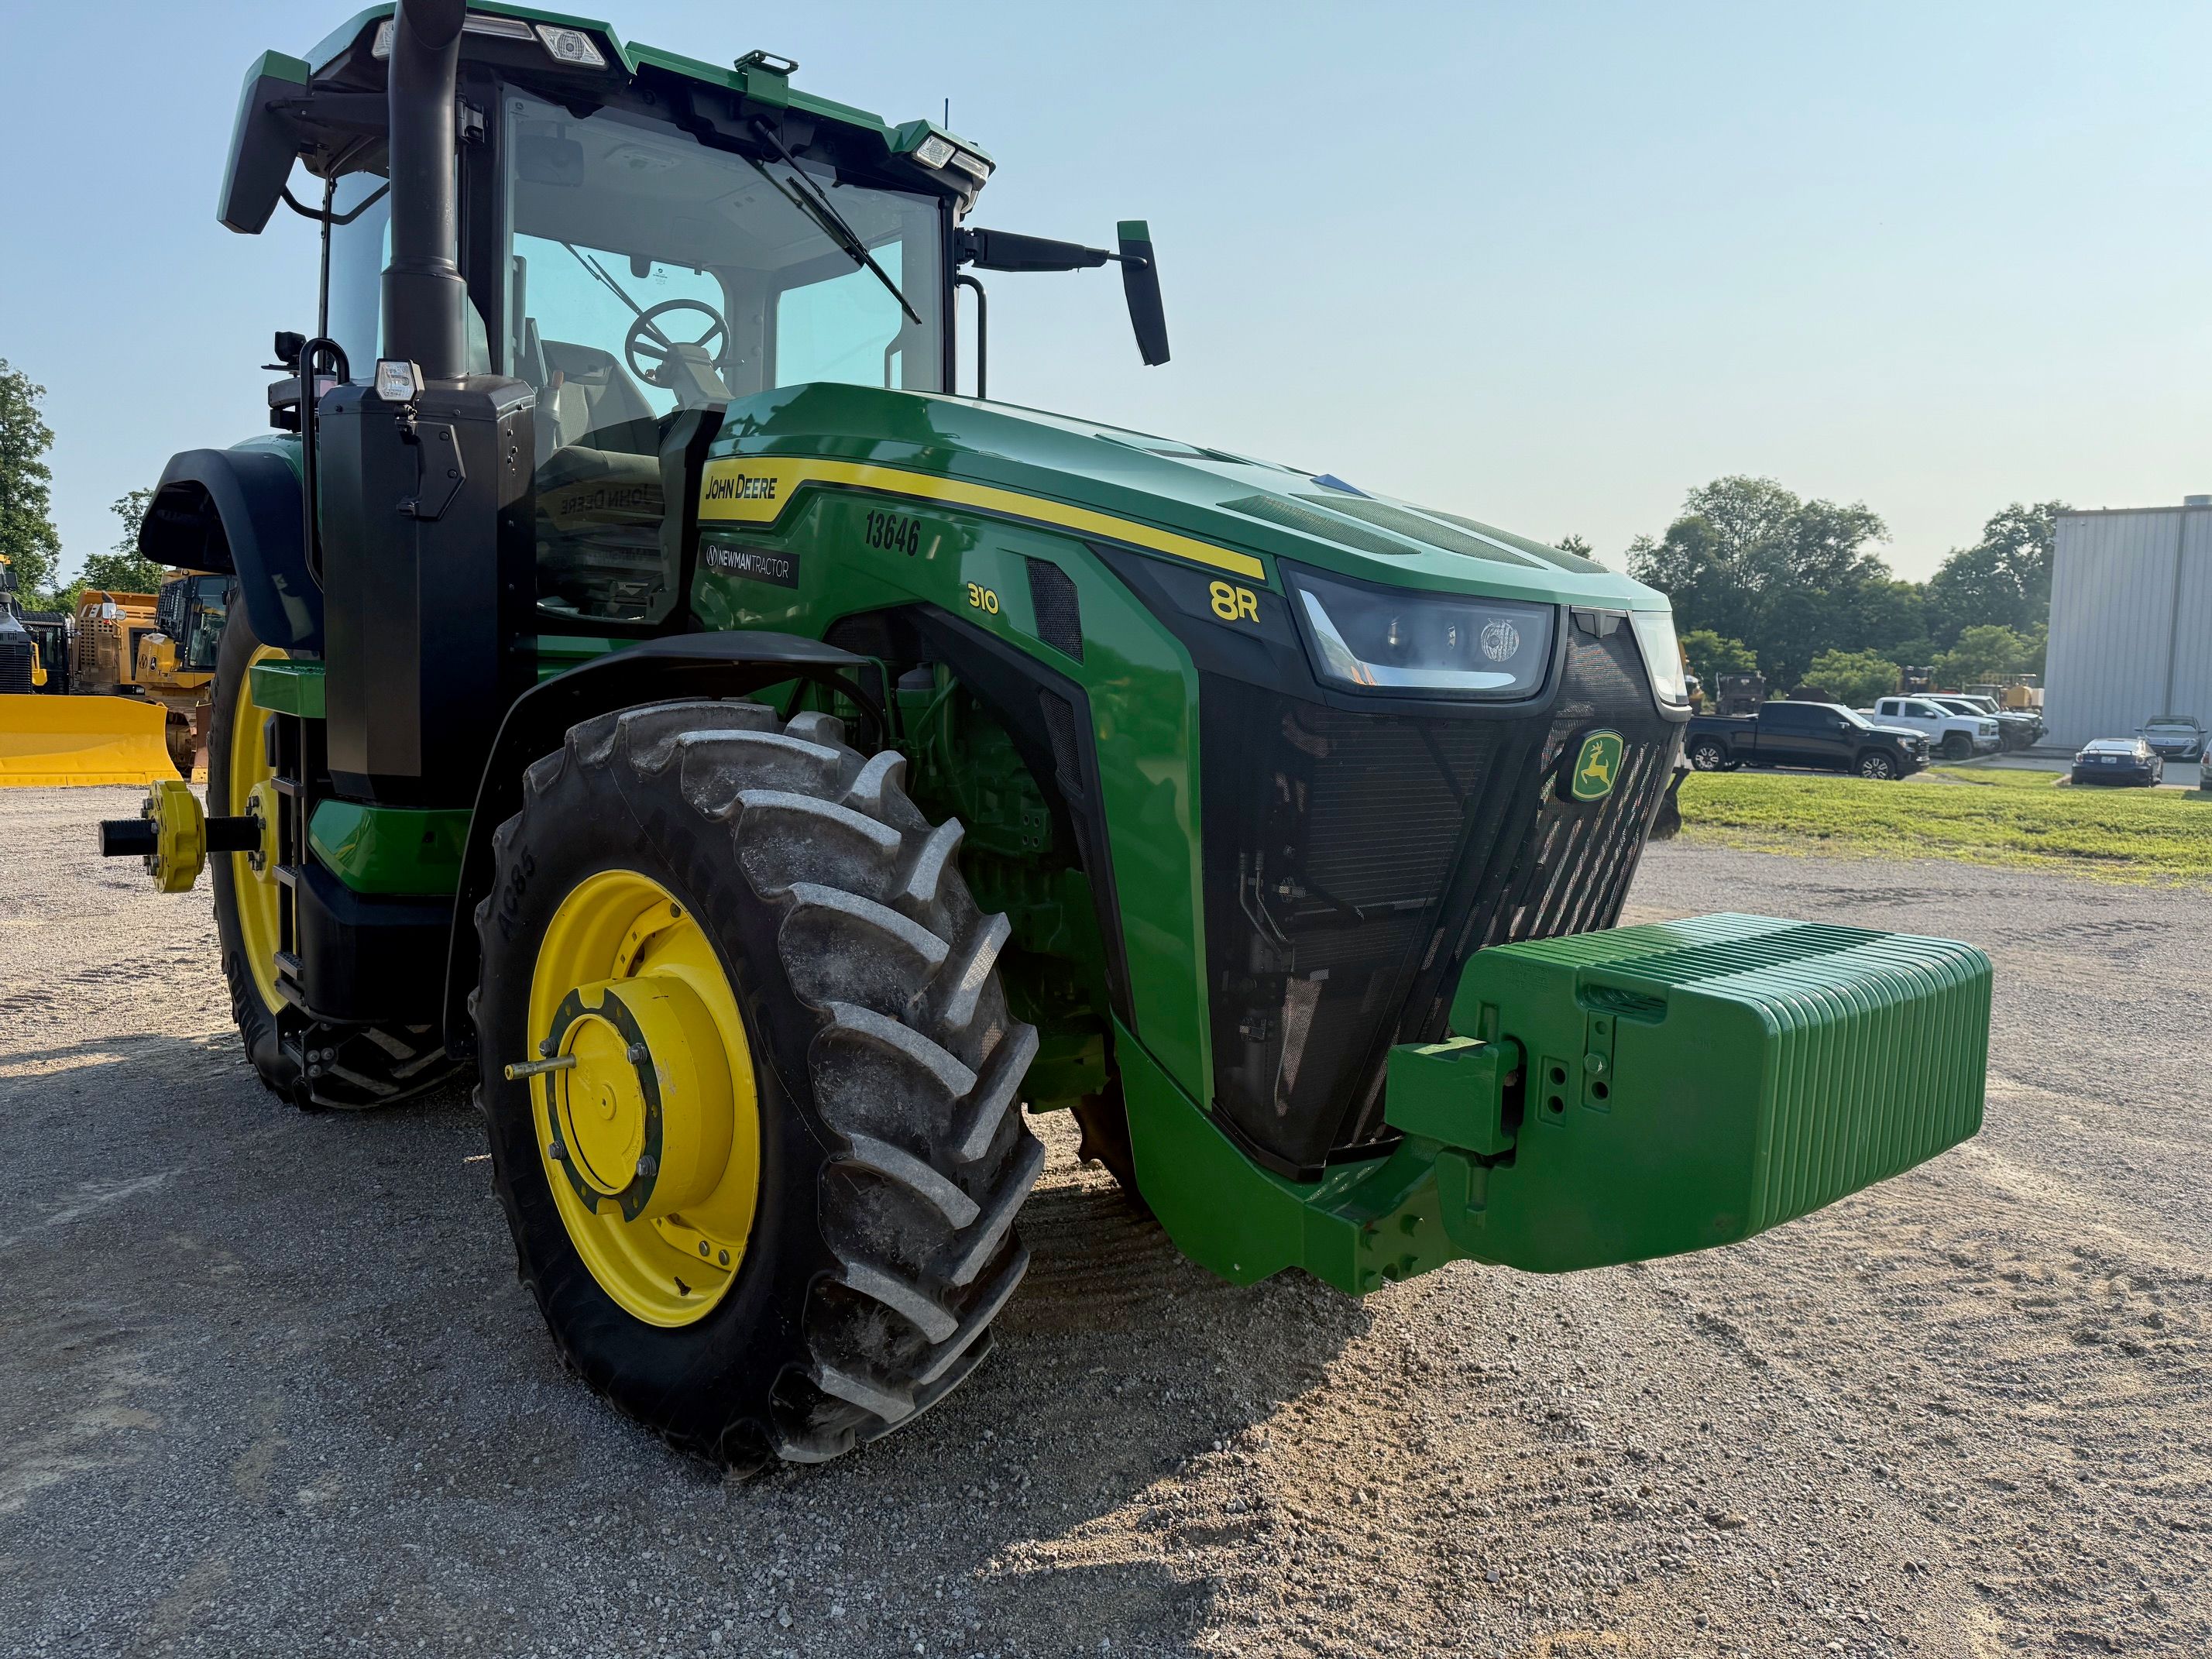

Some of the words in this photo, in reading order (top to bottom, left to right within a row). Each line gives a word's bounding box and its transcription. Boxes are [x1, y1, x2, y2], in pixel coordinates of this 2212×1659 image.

[705, 476, 735, 500] JOHN
[735, 474, 778, 500] DEERE
[865, 510, 921, 557] 13646
[967, 582, 1000, 615] 310
[1208, 580, 1261, 623] 8R
